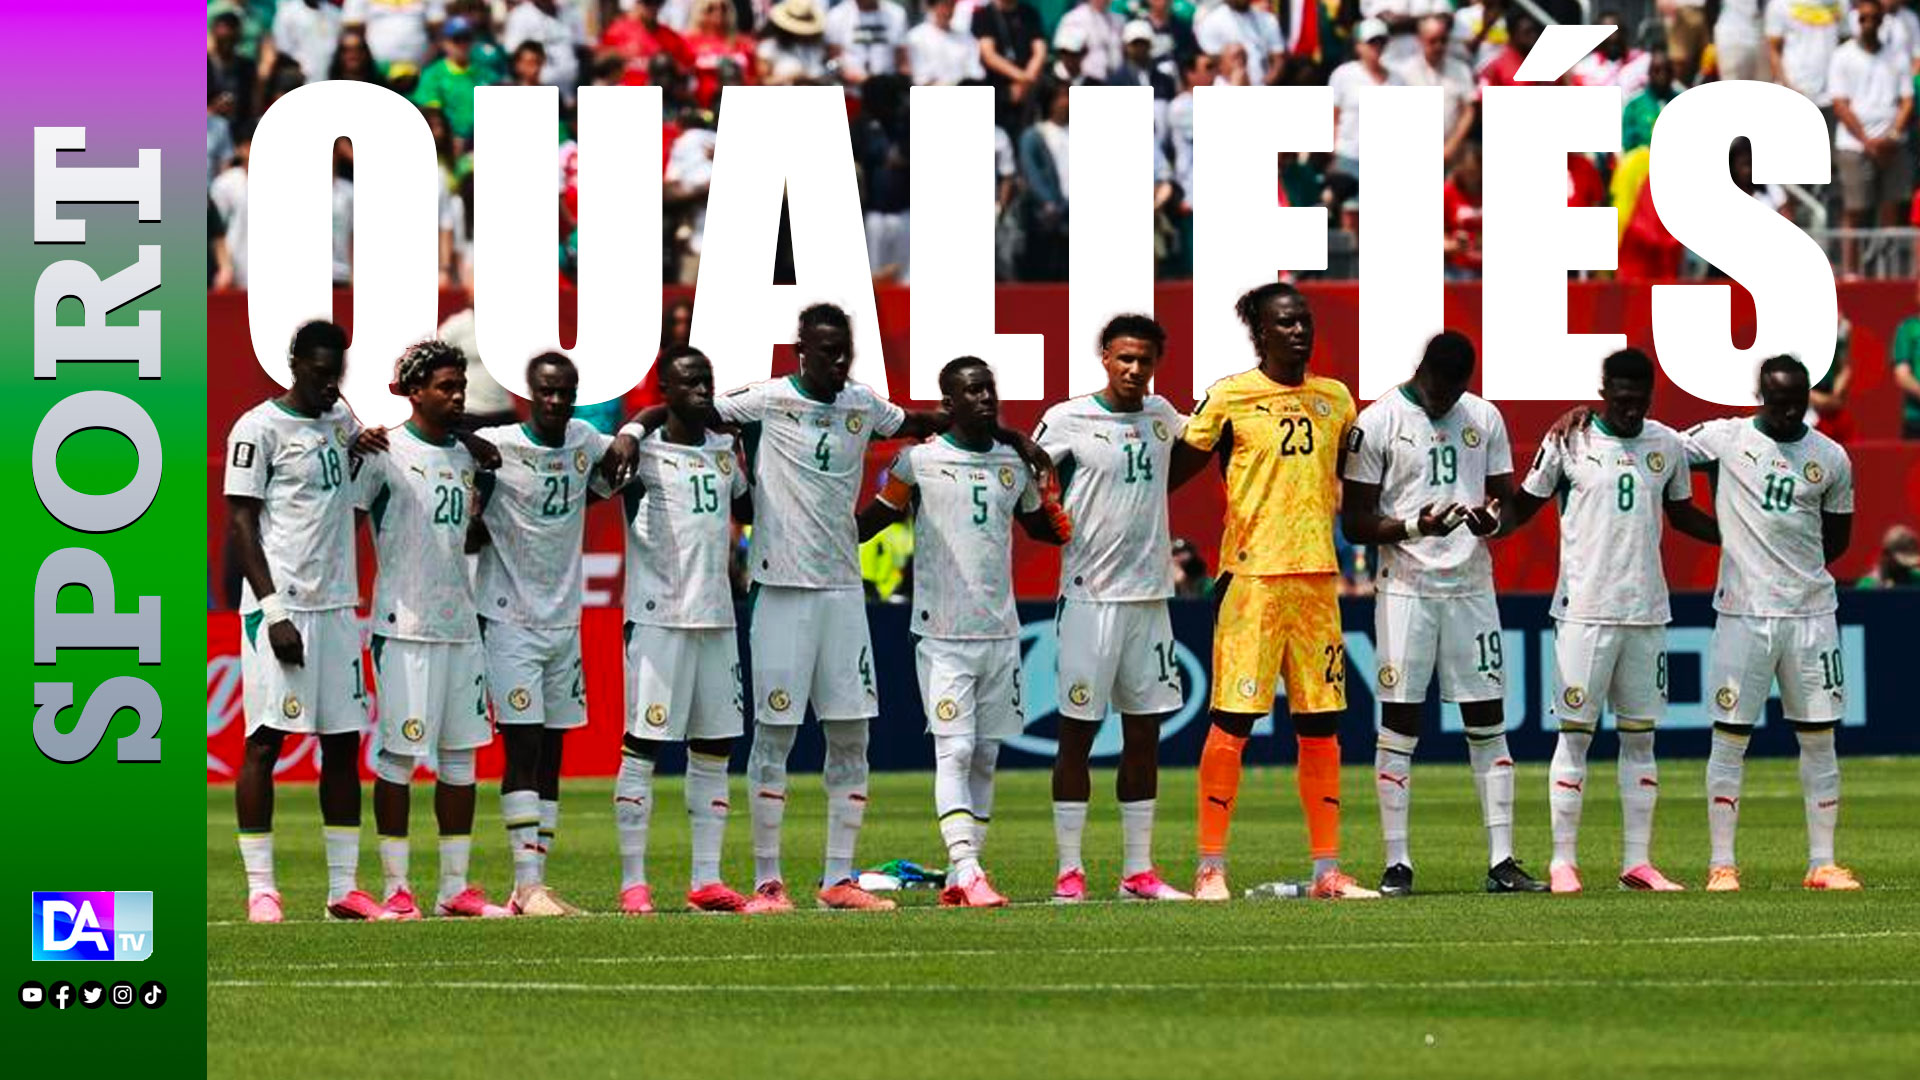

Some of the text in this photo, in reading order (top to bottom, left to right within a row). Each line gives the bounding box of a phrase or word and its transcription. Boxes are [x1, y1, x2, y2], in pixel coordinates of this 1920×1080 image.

[815, 432, 831, 471] 4
[1280, 417, 1314, 456] 23
[317, 448, 343, 491] 18
[1123, 441, 1153, 483] 14
[1429, 446, 1457, 486] 19
[435, 485, 463, 525] 20
[543, 475, 571, 516] 21
[690, 474, 719, 514] 15
[973, 486, 988, 525] 5
[1617, 473, 1635, 512] 8
[1761, 473, 1796, 512] 10
[1324, 645, 1344, 683] 23
[1475, 630, 1503, 672] 19
[1819, 648, 1844, 690] 10
